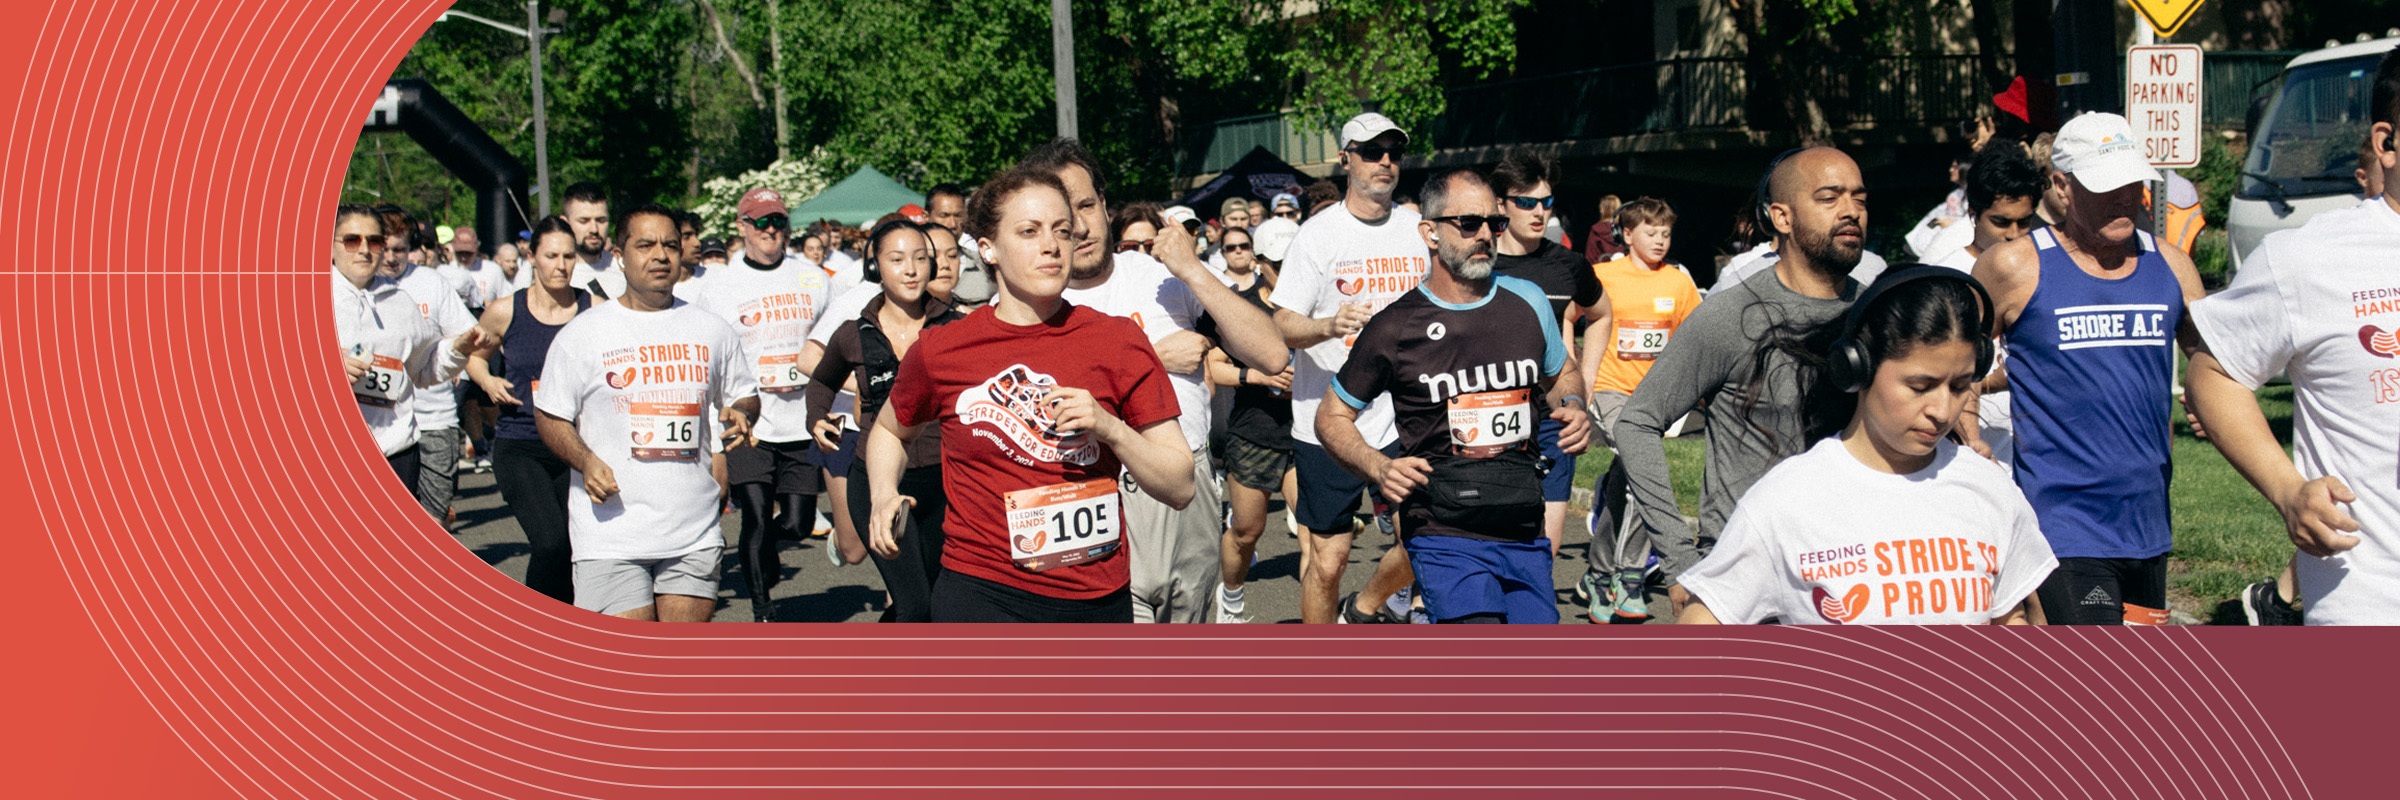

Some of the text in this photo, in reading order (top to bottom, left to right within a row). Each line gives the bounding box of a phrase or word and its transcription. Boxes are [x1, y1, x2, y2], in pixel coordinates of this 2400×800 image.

[2150, 54, 2178, 76] NO
[2133, 82, 2195, 104] PARKING
[2147, 110, 2180, 131] THIS
[2145, 137, 2179, 159] SIDE
[1336, 259, 1363, 267] FEEDING
[1336, 266, 1364, 275] HANDS
[1366, 257, 1425, 275] STRIDE TO
[762, 293, 812, 309] STRIDE TO
[2352, 288, 2400, 302] FEEDIN
[766, 308, 814, 323] PROVIDE
[2058, 314, 2126, 341] SHORE
[1643, 333, 1663, 348] 82
[602, 347, 635, 358] FEEDING
[603, 354, 636, 368] HANDS
[639, 344, 709, 363] STRIDE TO
[365, 371, 391, 392] 33
[642, 364, 709, 384] PROVIDE
[789, 366, 798, 381] 6
[1418, 358, 1539, 403] nuun
[2369, 368, 2400, 404] 1S
[666, 421, 692, 442] 16
[1451, 417, 1479, 425] HANDS
[1491, 411, 1521, 437] 64
[969, 406, 1018, 434] STRIDES
[1020, 433, 1038, 453] FOR
[1040, 443, 1099, 462] EDUCATION
[972, 428, 1008, 452] November
[1013, 455, 1034, 467] 2024
[1010, 509, 1045, 520] FEEDING
[1011, 517, 1046, 531] HANDS
[1052, 503, 1109, 543] 105
[1800, 543, 1867, 565] FEEDING
[1874, 537, 2000, 577] STRIDE TO
[1801, 558, 1868, 582] HANDS
[1882, 577, 1994, 617] PROVID
